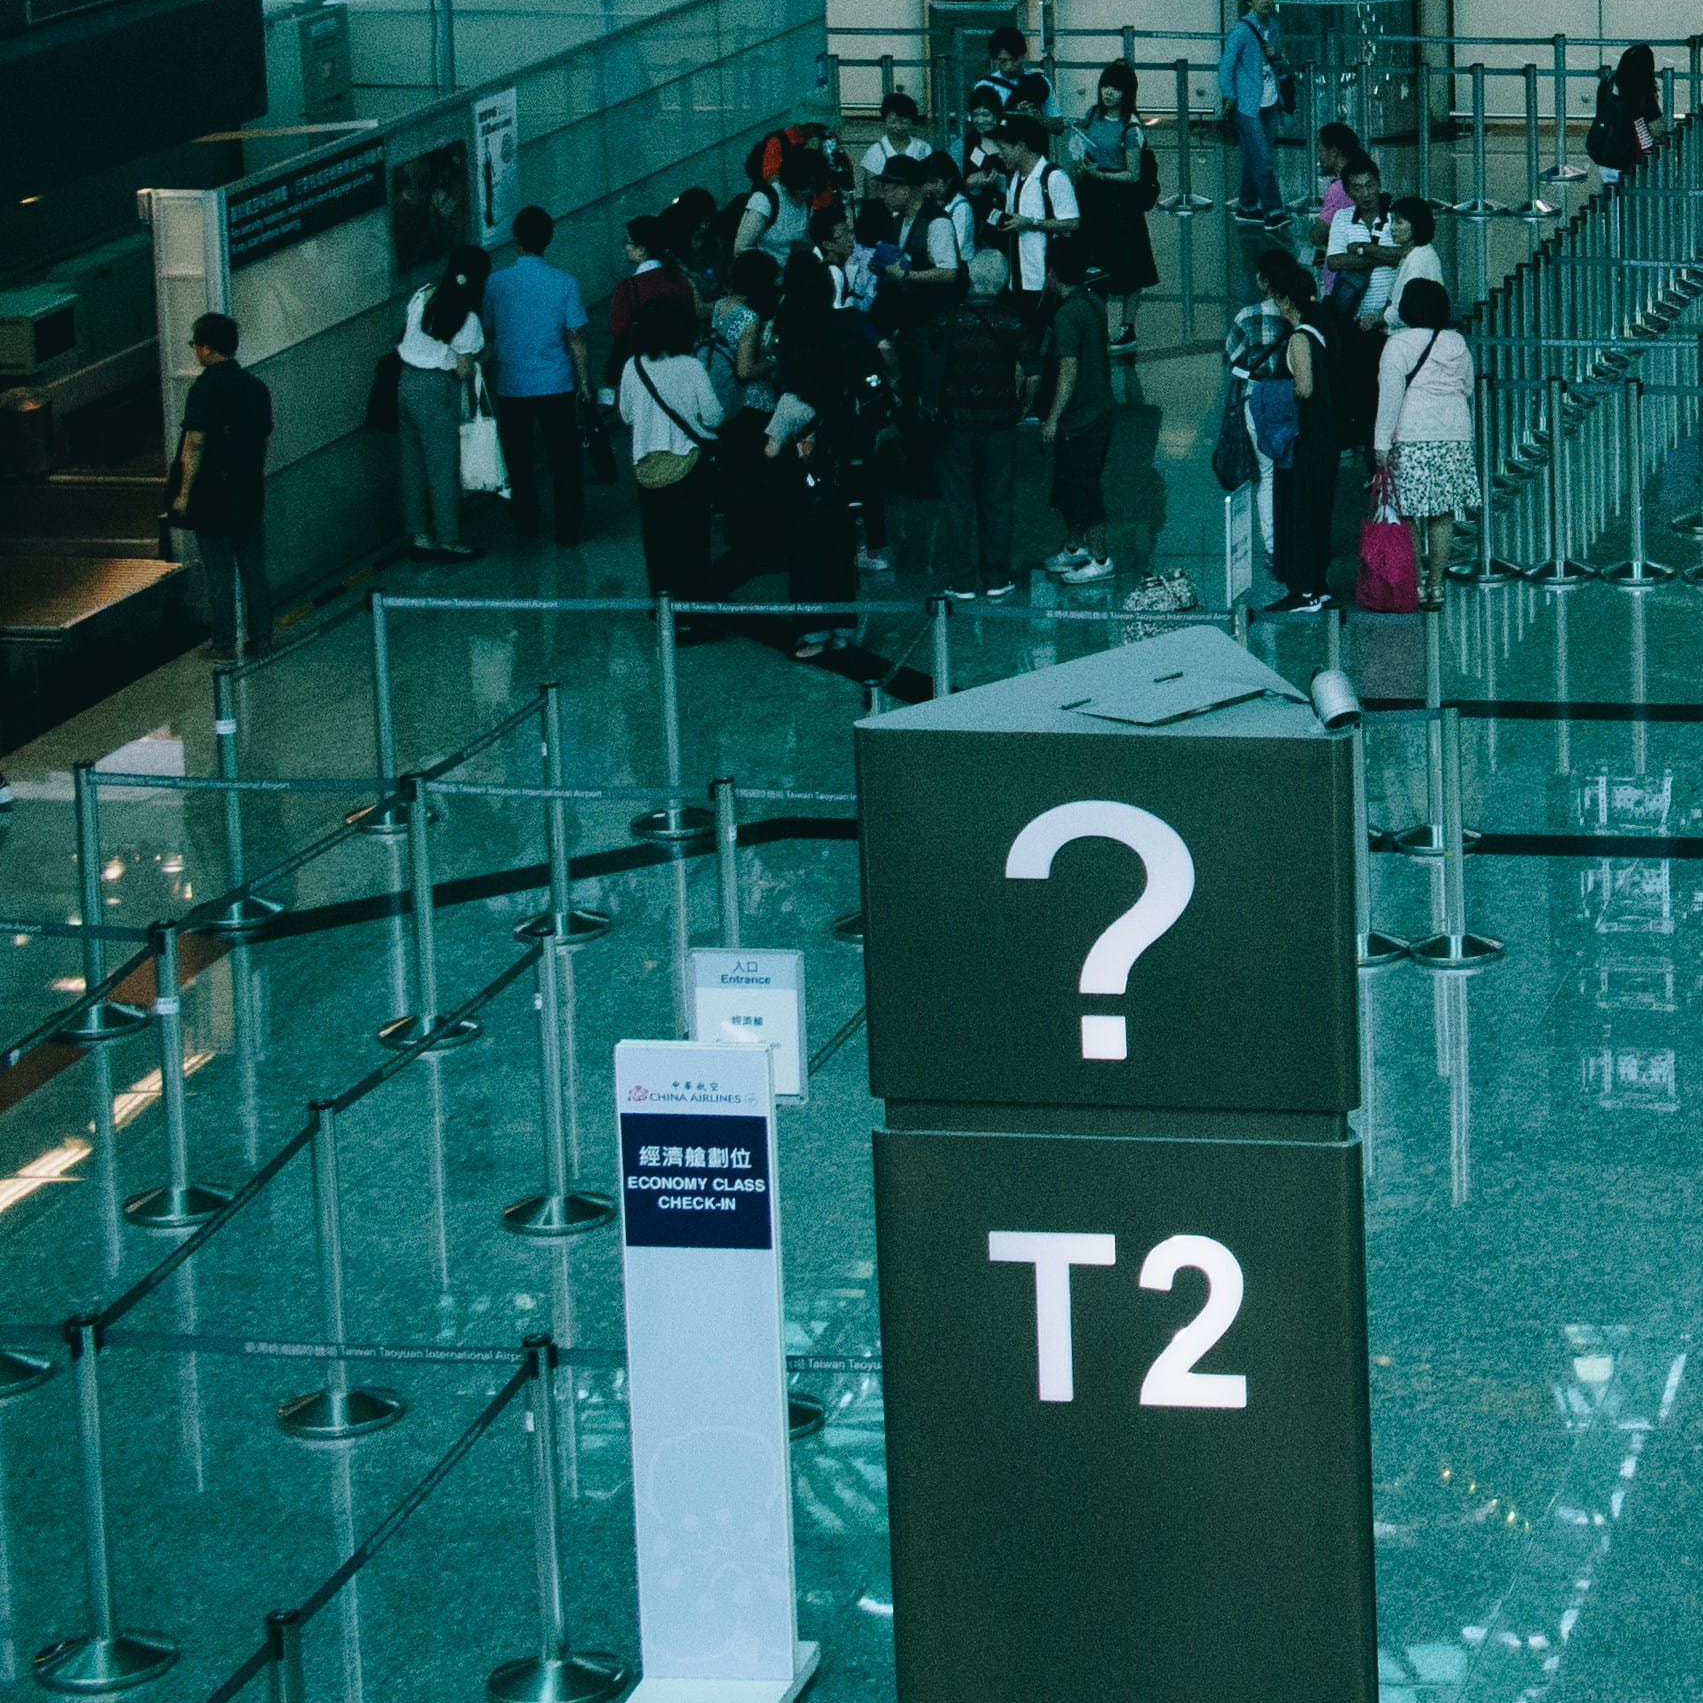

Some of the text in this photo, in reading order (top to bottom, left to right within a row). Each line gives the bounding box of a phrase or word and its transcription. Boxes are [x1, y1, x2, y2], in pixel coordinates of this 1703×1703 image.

[733, 961, 758, 973] 入口
[720, 974, 771, 985] Entrance
[650, 1092, 742, 1104] CHINA AIRLINES
[639, 1145, 752, 1169] 經濟艙劃位
[627, 1176, 766, 1192] ECONOMY CLASS
[658, 1196, 736, 1211] CHECK-IN
[988, 1230, 1248, 1409] T2
[808, 1357, 846, 1369] Taiwan
